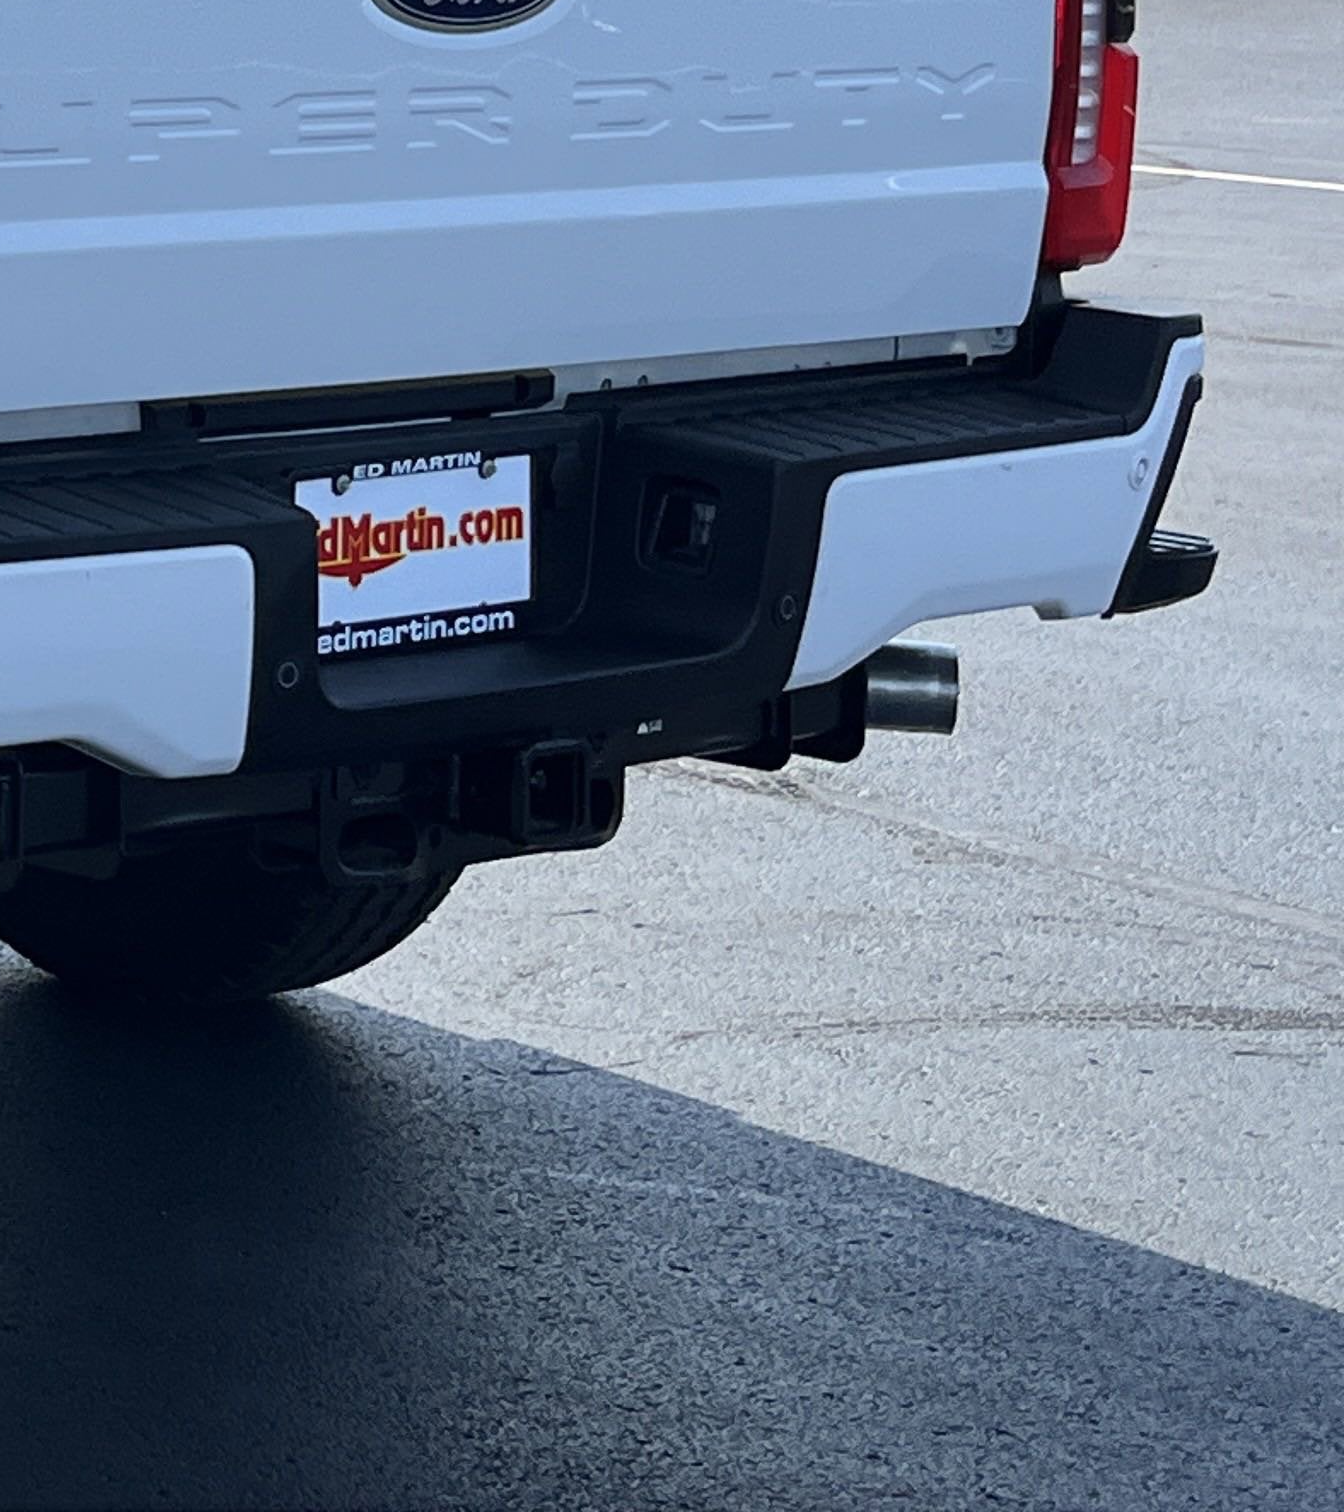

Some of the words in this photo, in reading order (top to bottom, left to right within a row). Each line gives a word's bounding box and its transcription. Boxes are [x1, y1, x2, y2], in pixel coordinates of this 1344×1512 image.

[570, 62, 996, 141] DUTY
[352, 464, 384, 480] ED
[391, 450, 482, 476] MARTIN
[317, 506, 524, 570] dMartin.com
[317, 609, 515, 654] edmartin.com
